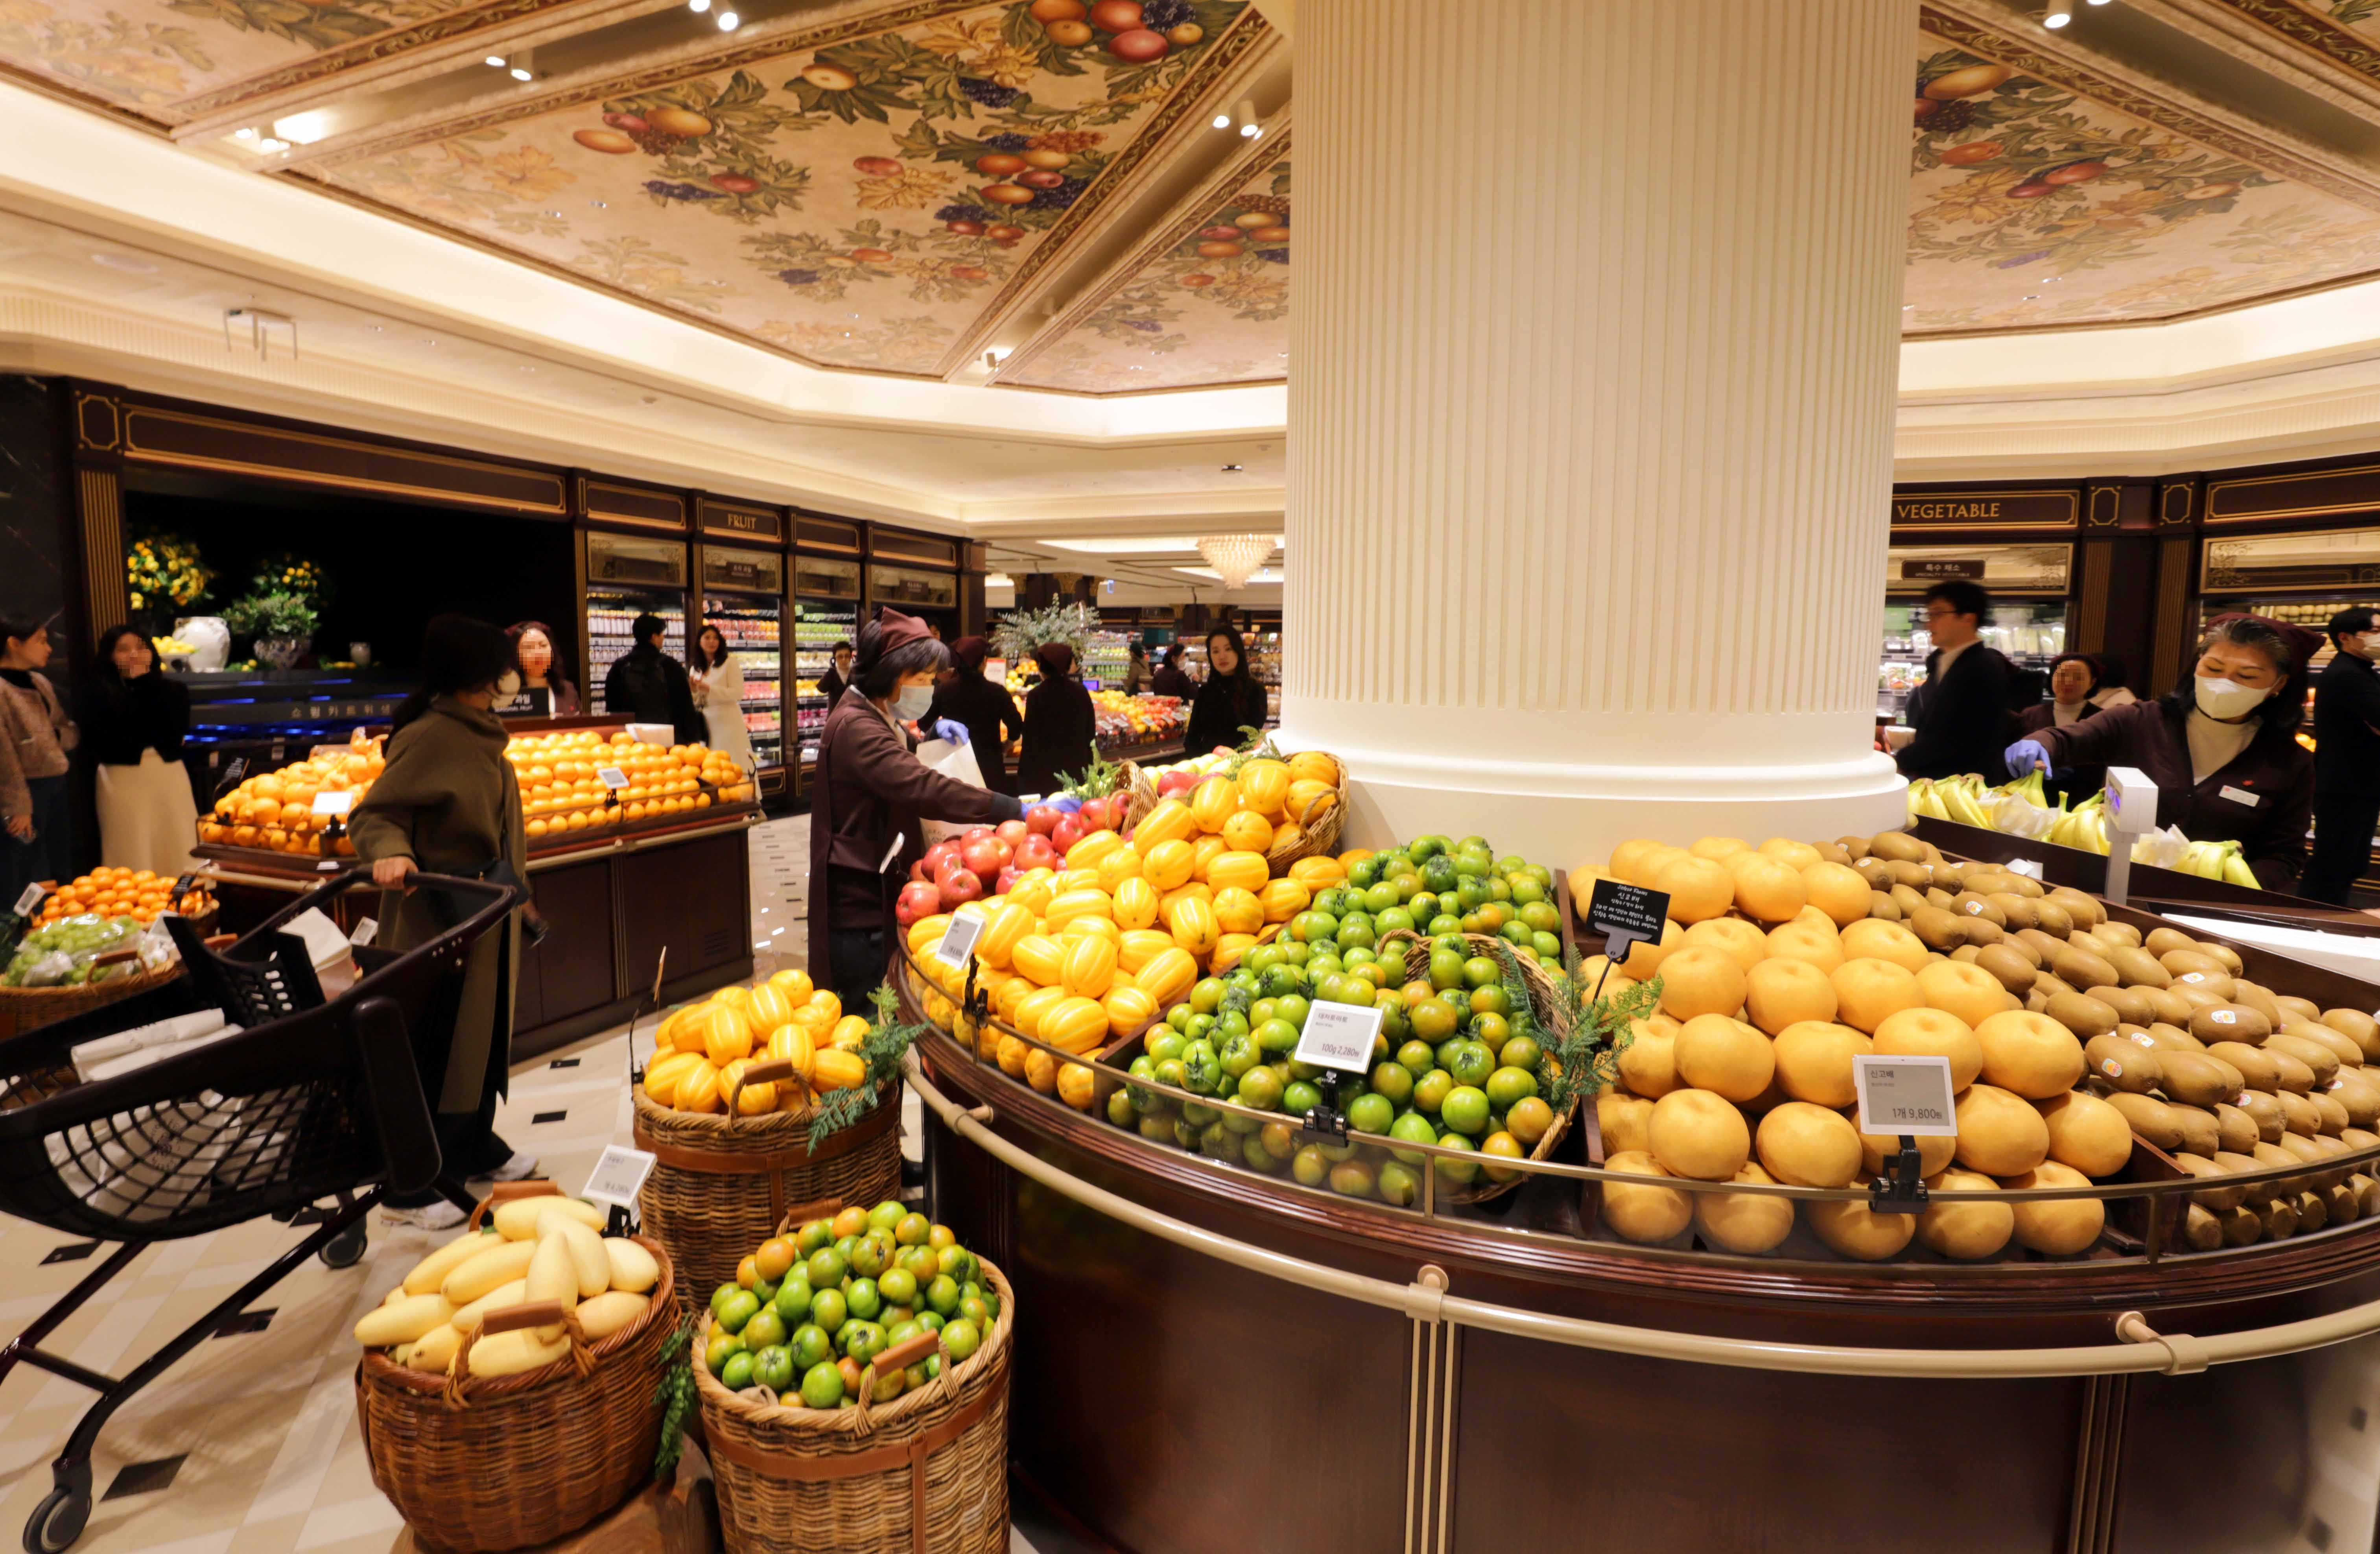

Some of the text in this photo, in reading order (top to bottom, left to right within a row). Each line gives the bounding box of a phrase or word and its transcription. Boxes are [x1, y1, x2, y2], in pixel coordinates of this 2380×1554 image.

[1897, 503, 2000, 518] VEGETABLE
[727, 513, 757, 530] FRUIT
[1321, 1043, 1337, 1055] 100g
[1870, 1070, 1894, 1079] 신고배
[1892, 1108, 1942, 1121] 1개 9,800원
